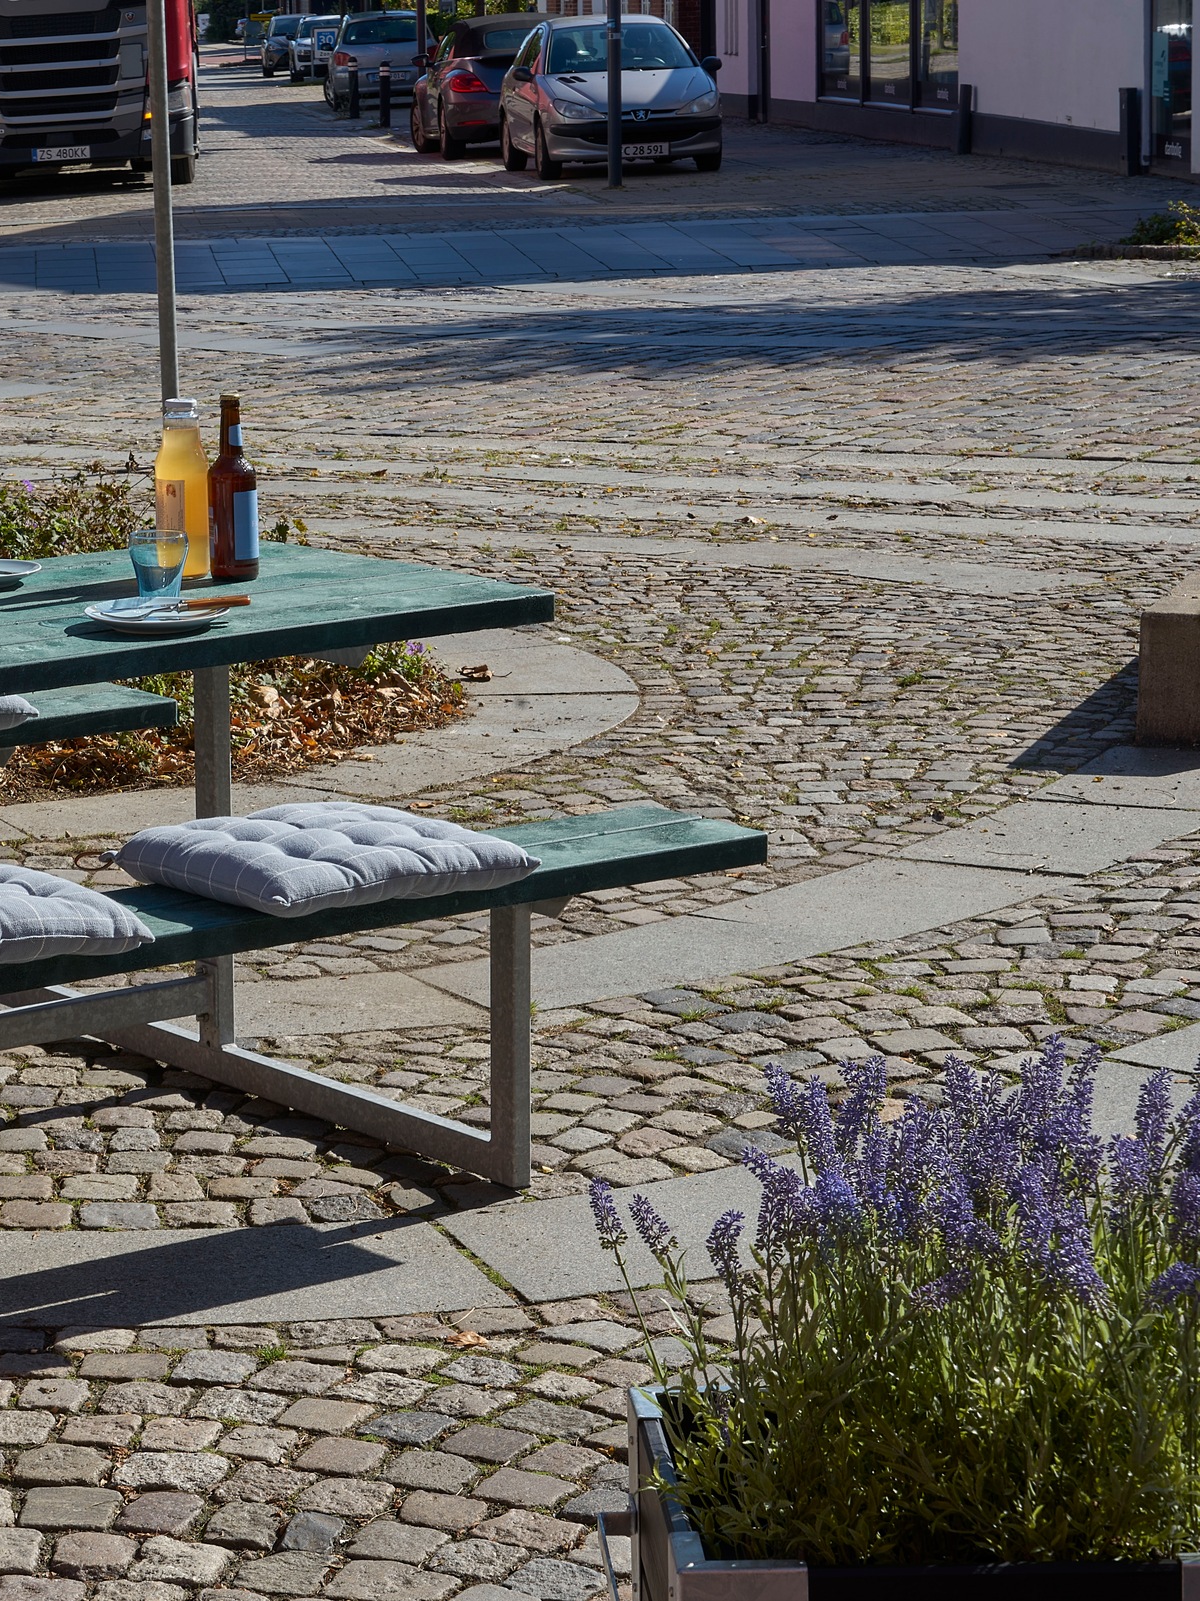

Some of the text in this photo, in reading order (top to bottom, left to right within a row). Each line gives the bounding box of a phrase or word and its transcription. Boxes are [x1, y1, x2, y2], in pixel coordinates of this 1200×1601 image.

[319, 35, 334, 45] 30
[39, 147, 87, 160] ZS 480KK
[632, 145, 645, 156] 28
[647, 144, 664, 155] 591
